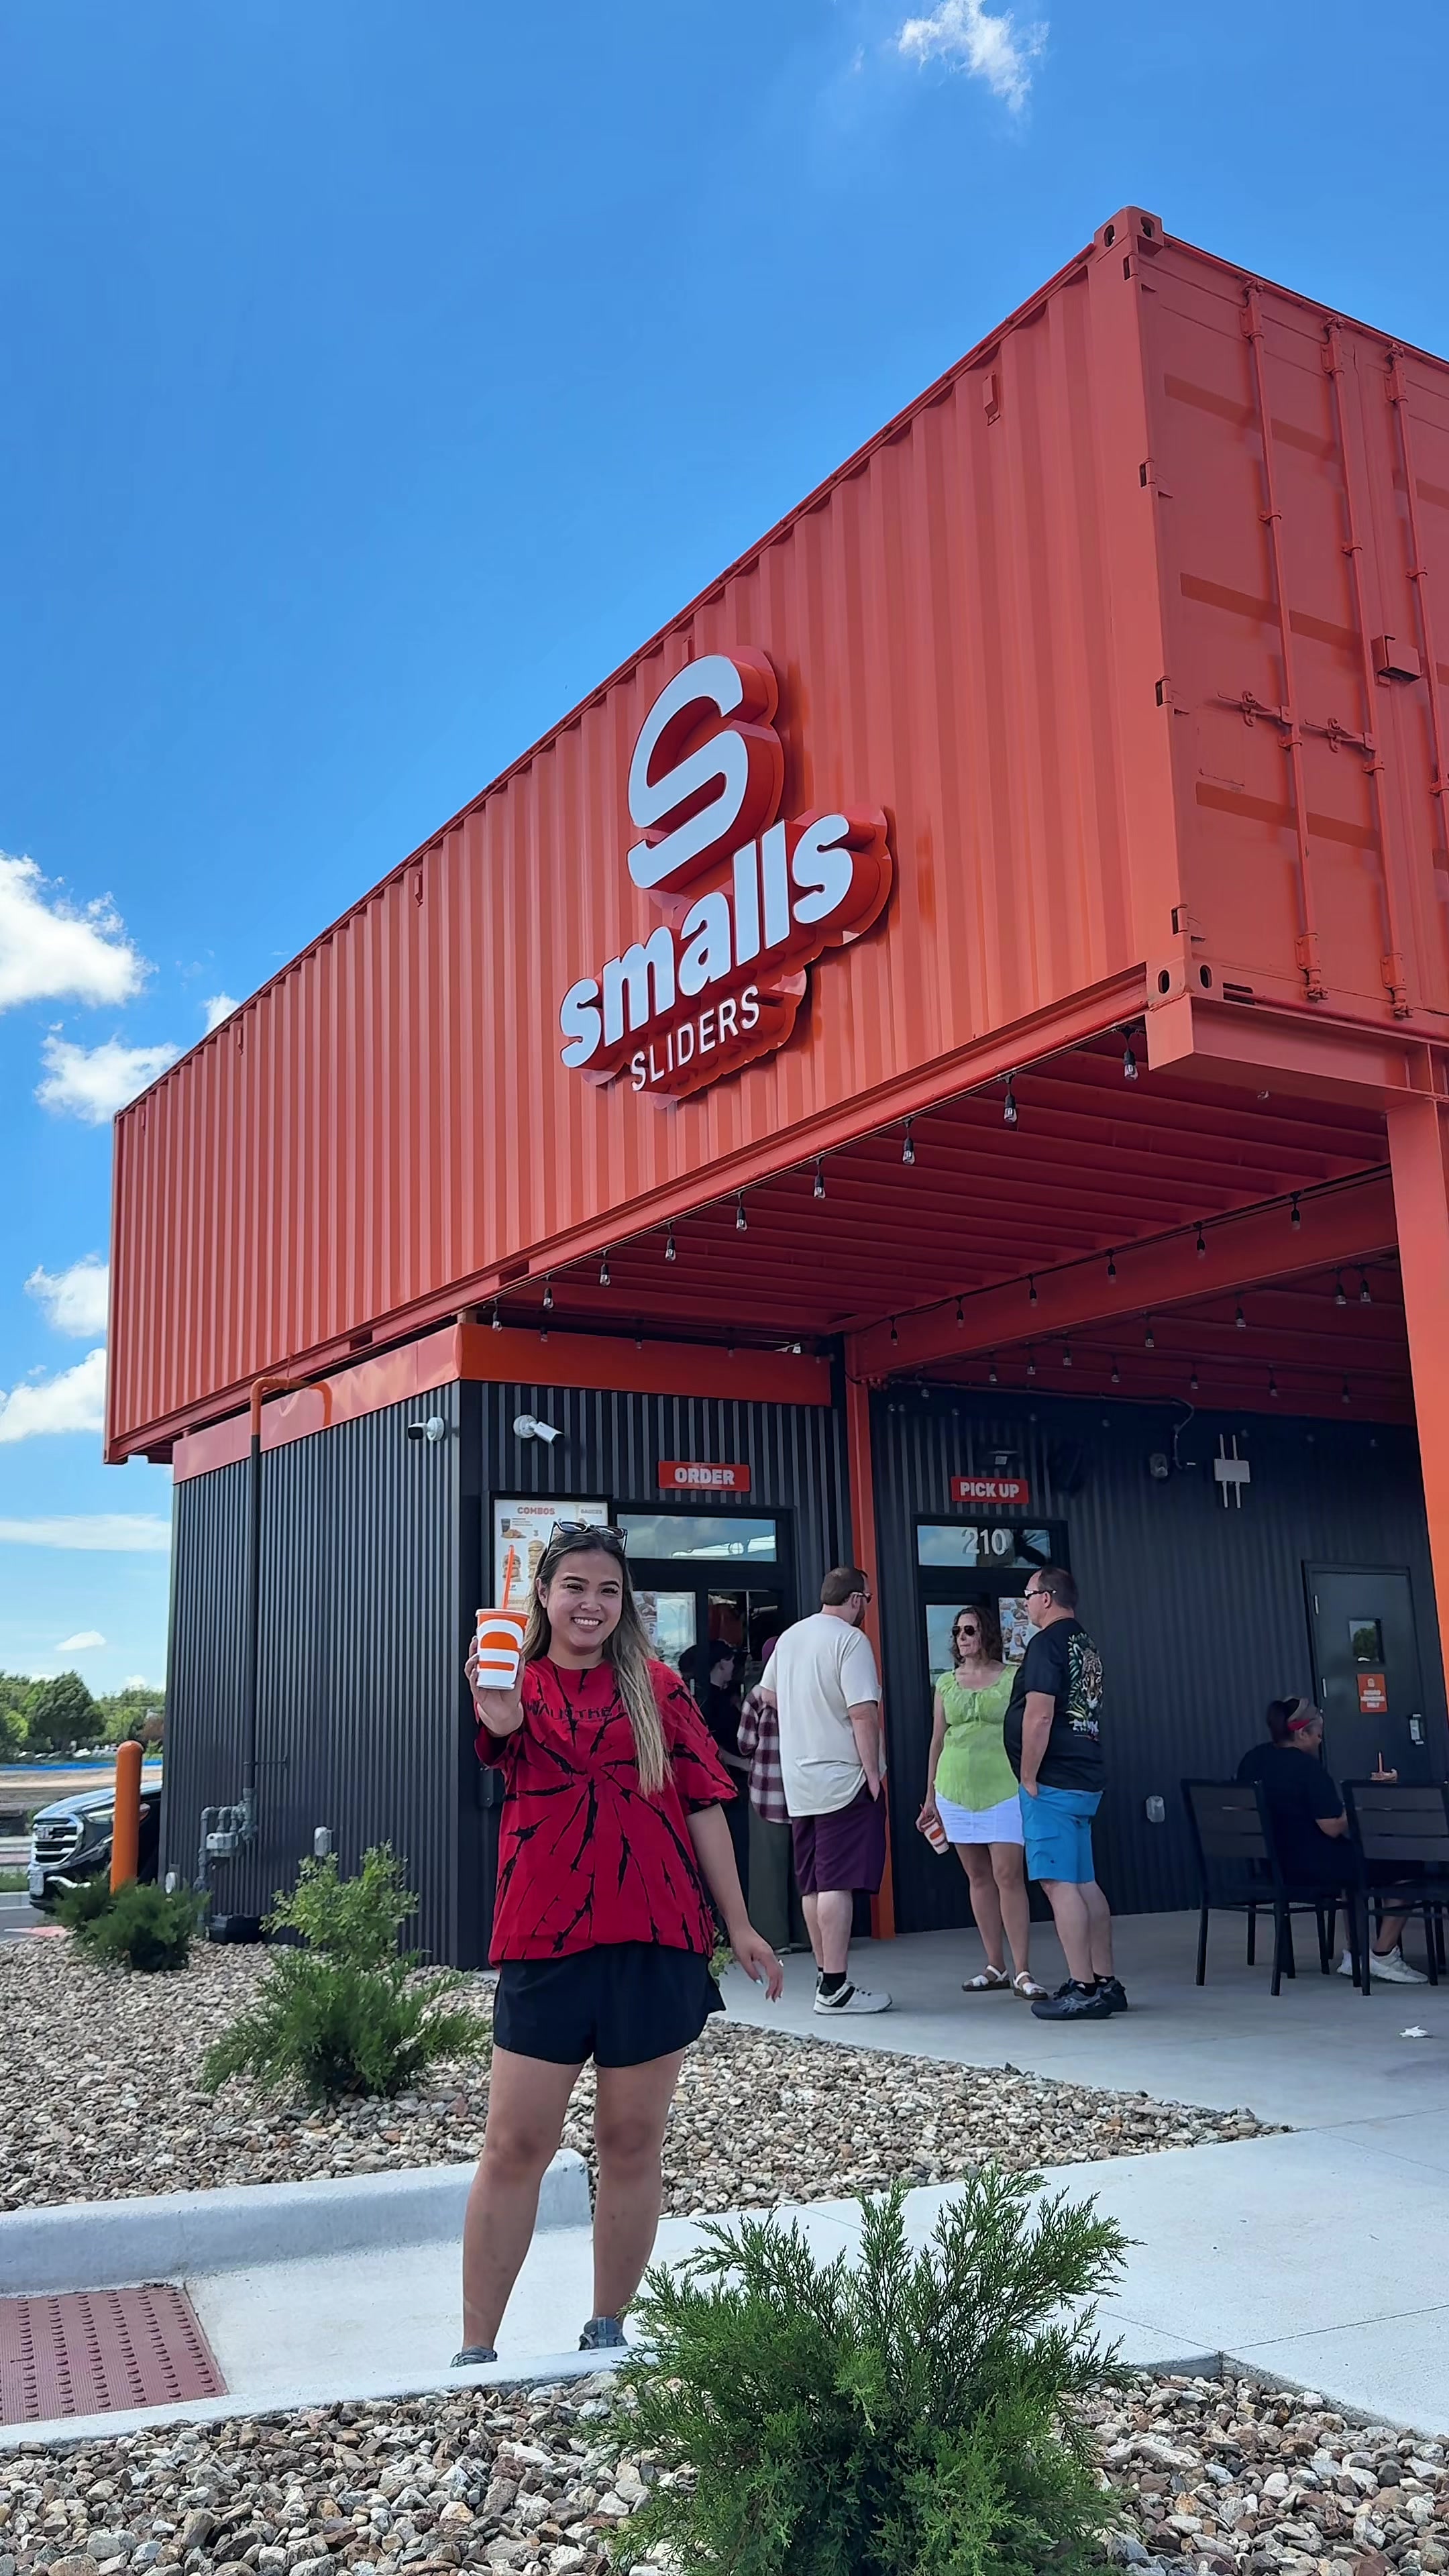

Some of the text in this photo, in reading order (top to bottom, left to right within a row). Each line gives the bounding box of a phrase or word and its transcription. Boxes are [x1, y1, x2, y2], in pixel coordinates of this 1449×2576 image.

[559, 813, 853, 1069] smalls
[630, 984, 761, 1092] SLIDERS
[674, 1467, 735, 1485] ORDER
[959, 1481, 1020, 1498] PICK UP
[517, 1506, 555, 1515] COMBOS
[963, 1529, 1007, 1555] 210
